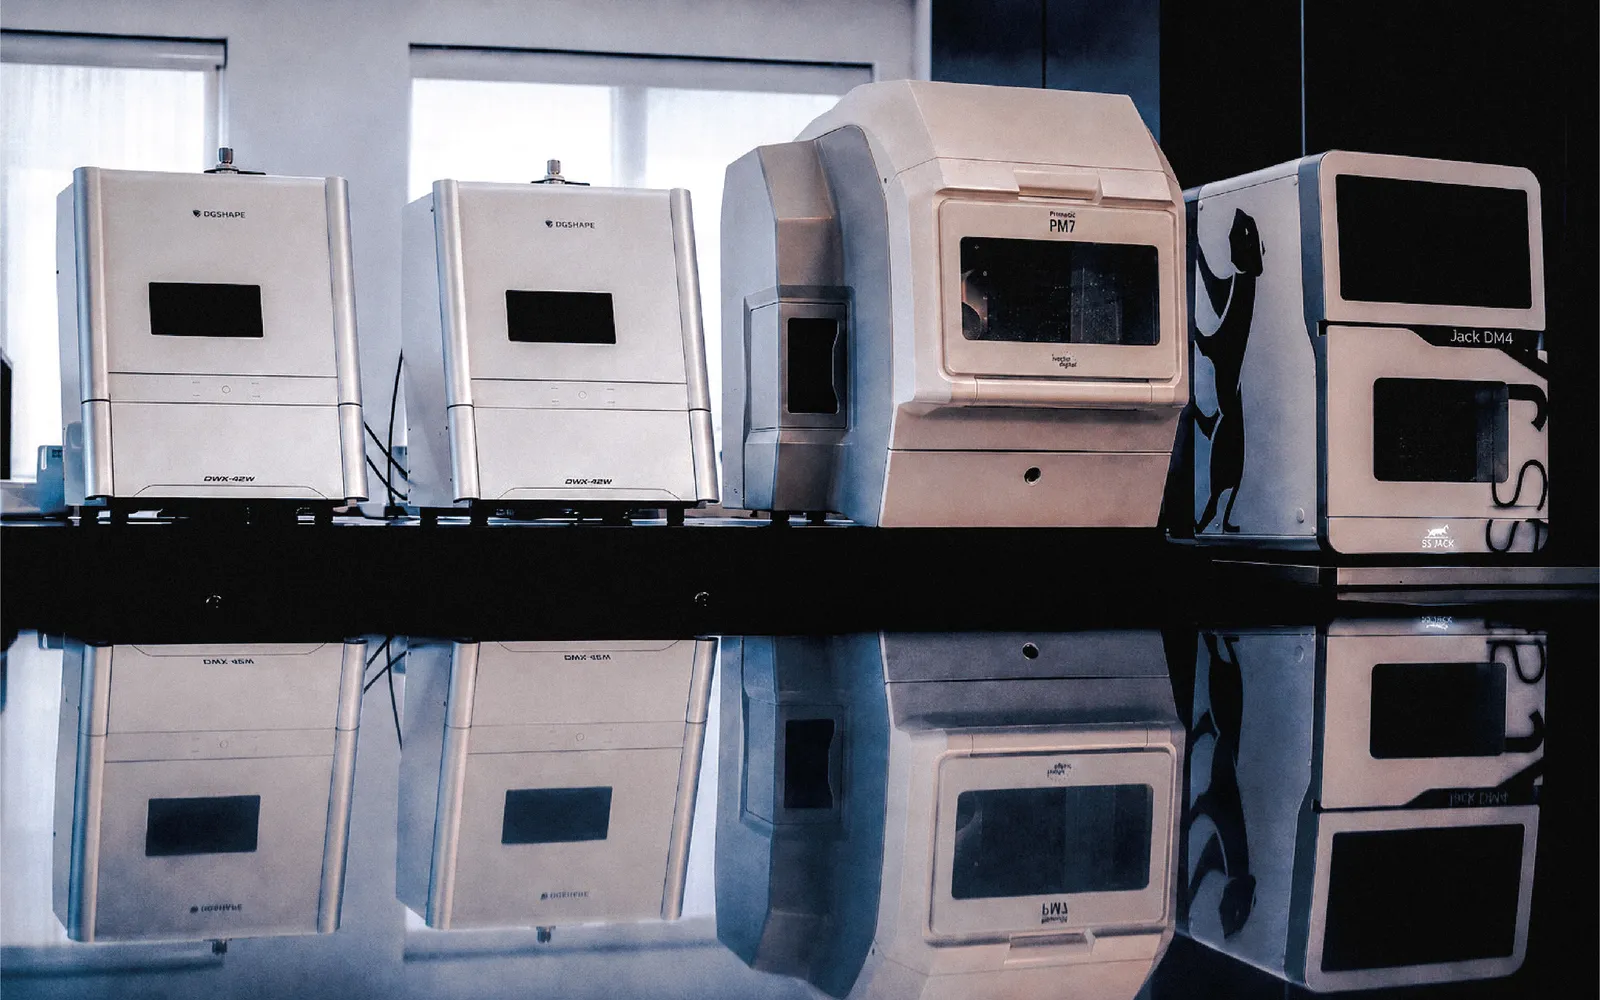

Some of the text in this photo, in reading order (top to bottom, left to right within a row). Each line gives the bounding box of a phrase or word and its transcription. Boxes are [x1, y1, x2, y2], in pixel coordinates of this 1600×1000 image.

[203, 210, 246, 218] DGSHAPE
[555, 221, 596, 229] DGSHAPE
[1049, 219, 1076, 233] PM7
[1450, 329, 1513, 344] Jack DM4
[1421, 539, 1455, 548] SS JACK
